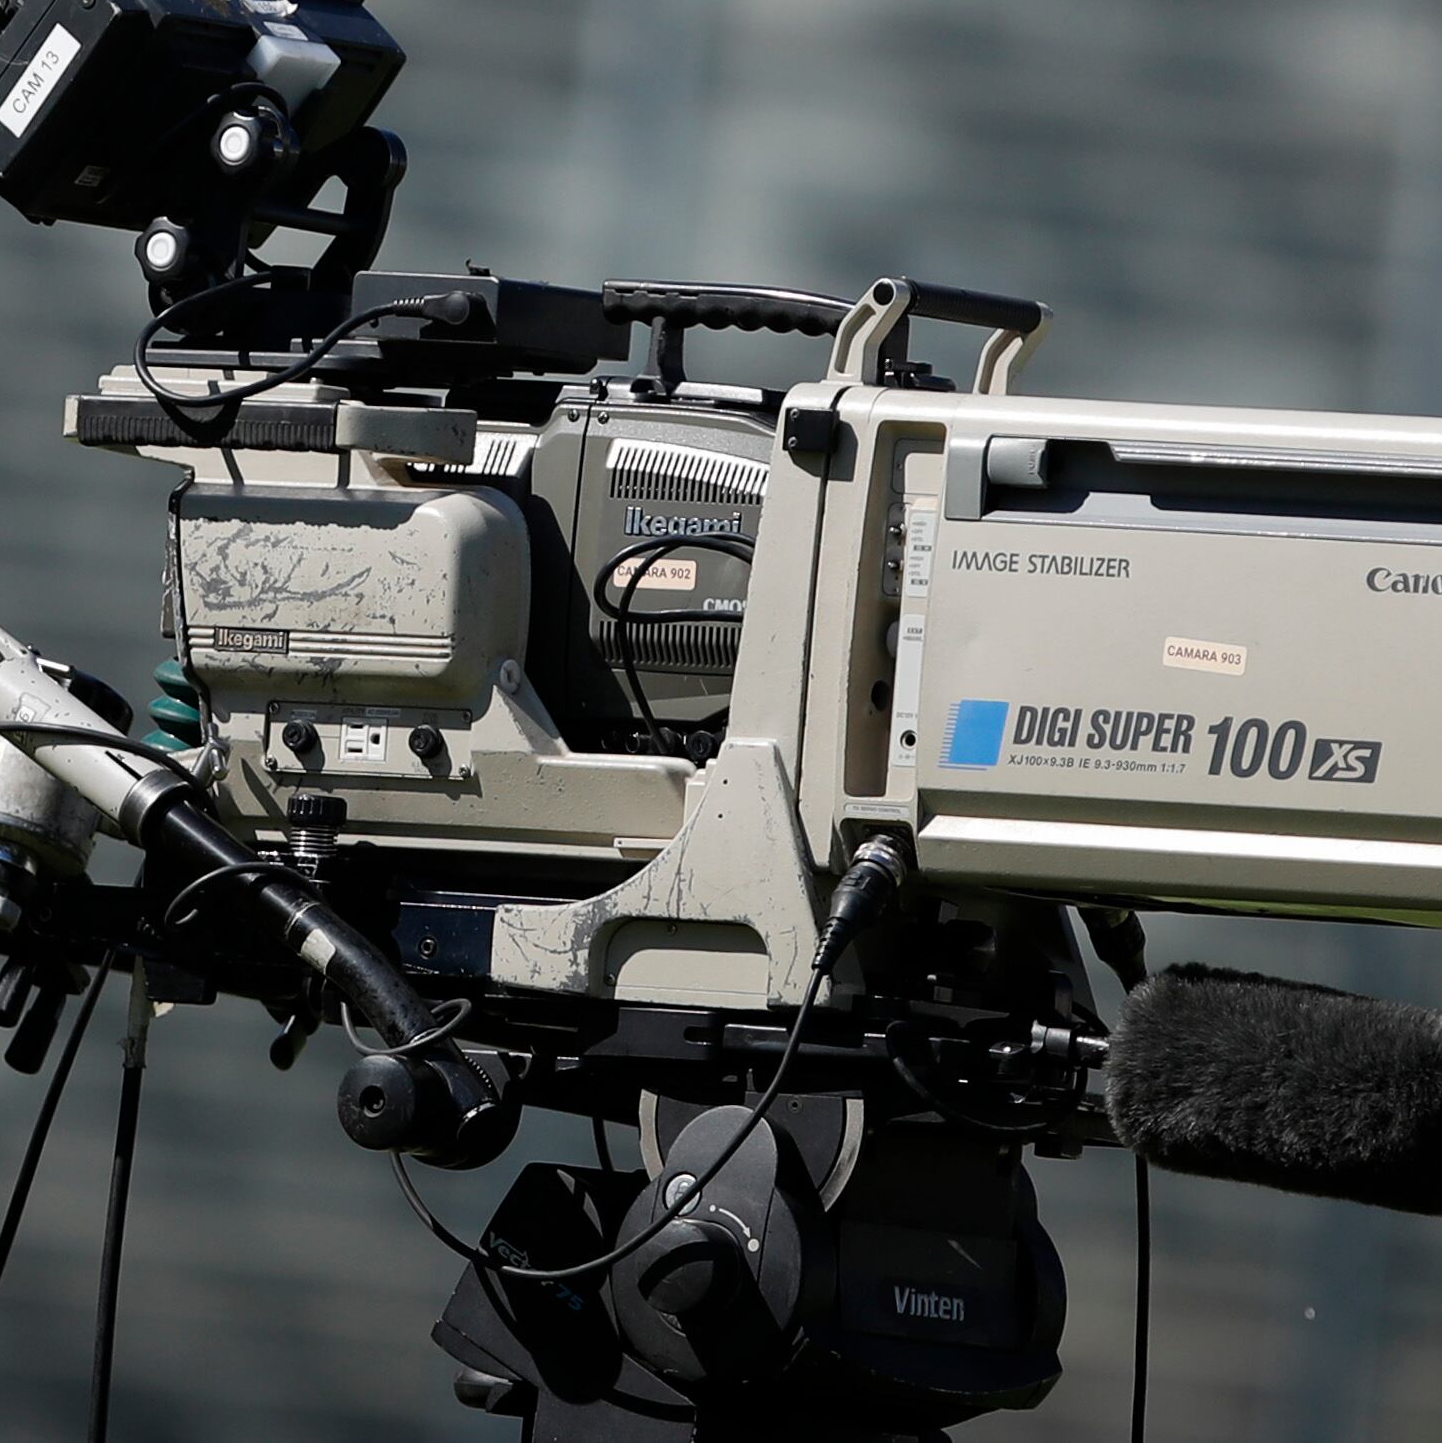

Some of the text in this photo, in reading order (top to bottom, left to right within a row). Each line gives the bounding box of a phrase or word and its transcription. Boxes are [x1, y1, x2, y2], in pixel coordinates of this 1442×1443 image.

[12, 50, 59, 114] CAM 13
[671, 567, 691, 580] 902
[952, 550, 1130, 578] IMAGE STABILIZER
[703, 597, 748, 612] CMO
[218, 628, 284, 650] Ikegami
[1167, 645, 1242, 665] CAMARA 903
[1013, 705, 1372, 781] DIGI SUPER 100 XS
[1078, 758, 1090, 769] IE
[1094, 759, 1157, 772] 9.3-930mm
[1161, 763, 1186, 774] 1:1.7
[894, 1286, 965, 1321] Vinten
